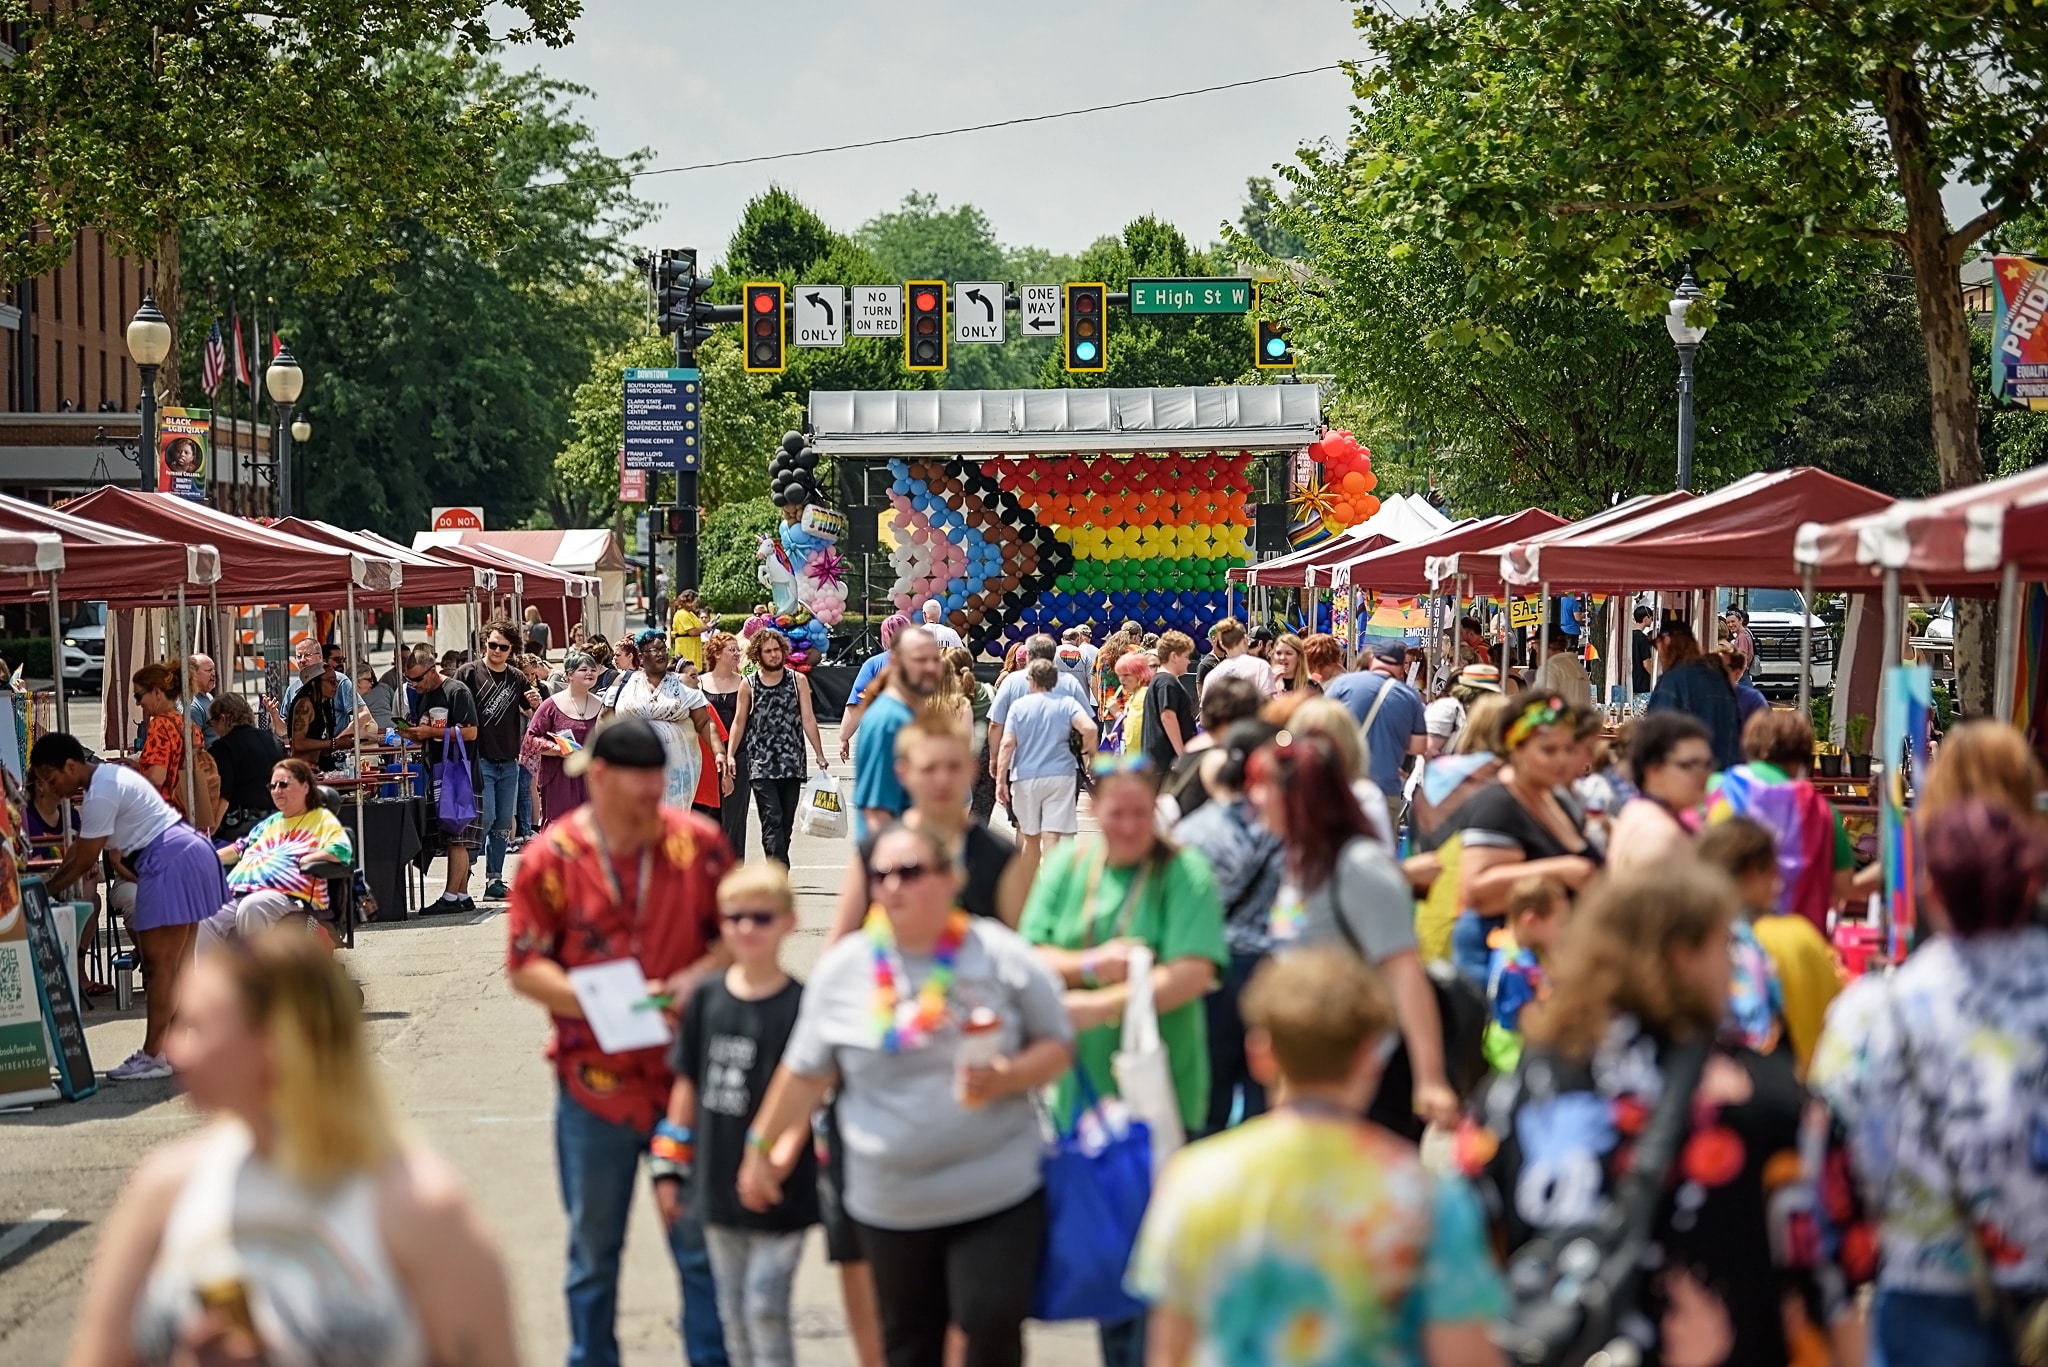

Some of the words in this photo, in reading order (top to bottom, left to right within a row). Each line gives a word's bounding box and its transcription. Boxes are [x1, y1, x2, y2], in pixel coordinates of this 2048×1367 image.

[868, 292, 887, 302] NO
[1028, 288, 1054, 300] ONE
[1136, 290, 1146, 305] E
[1155, 289, 1194, 309] High
[1204, 289, 1222, 304] St
[1232, 289, 1245, 304] W
[2001, 268, 2038, 331] SPRINGFIELD
[863, 306, 892, 316] TURN
[1027, 303, 1056, 314] WAY
[856, 320, 871, 330] ON
[876, 320, 898, 330] RED
[801, 329, 837, 341] ONLY
[961, 326, 998, 338] ONLY
[637, 370, 669, 379] DOWNTOWN
[165, 417, 191, 426] BLACK
[168, 425, 205, 434] LGBTQIA+
[440, 517, 453, 527] DO
[457, 516, 476, 526] NOT
[1512, 600, 1544, 617] SAE
